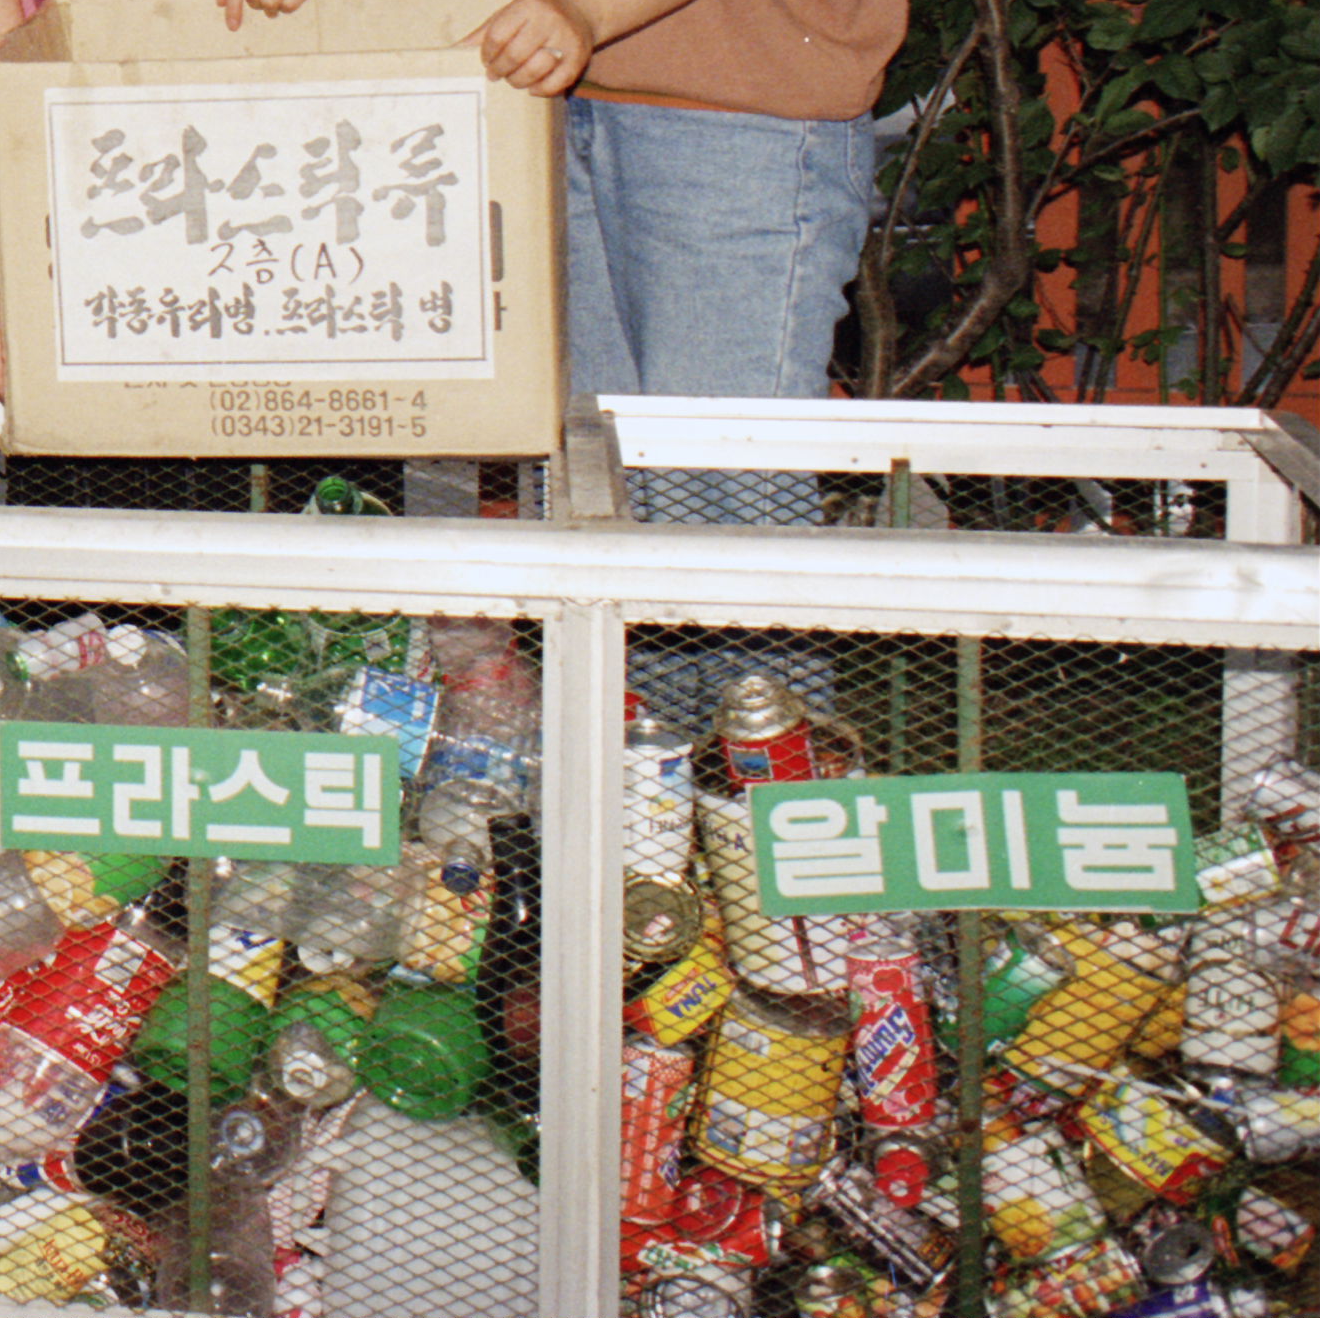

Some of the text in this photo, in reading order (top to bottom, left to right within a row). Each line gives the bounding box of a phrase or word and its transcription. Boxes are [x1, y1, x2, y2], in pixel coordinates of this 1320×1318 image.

[80, 119, 459, 247] 프라스틱류
[11, 741, 383, 849] 프라스틱
[769, 789, 1179, 899] 알미늄
[666, 975, 718, 1019] TUNA
